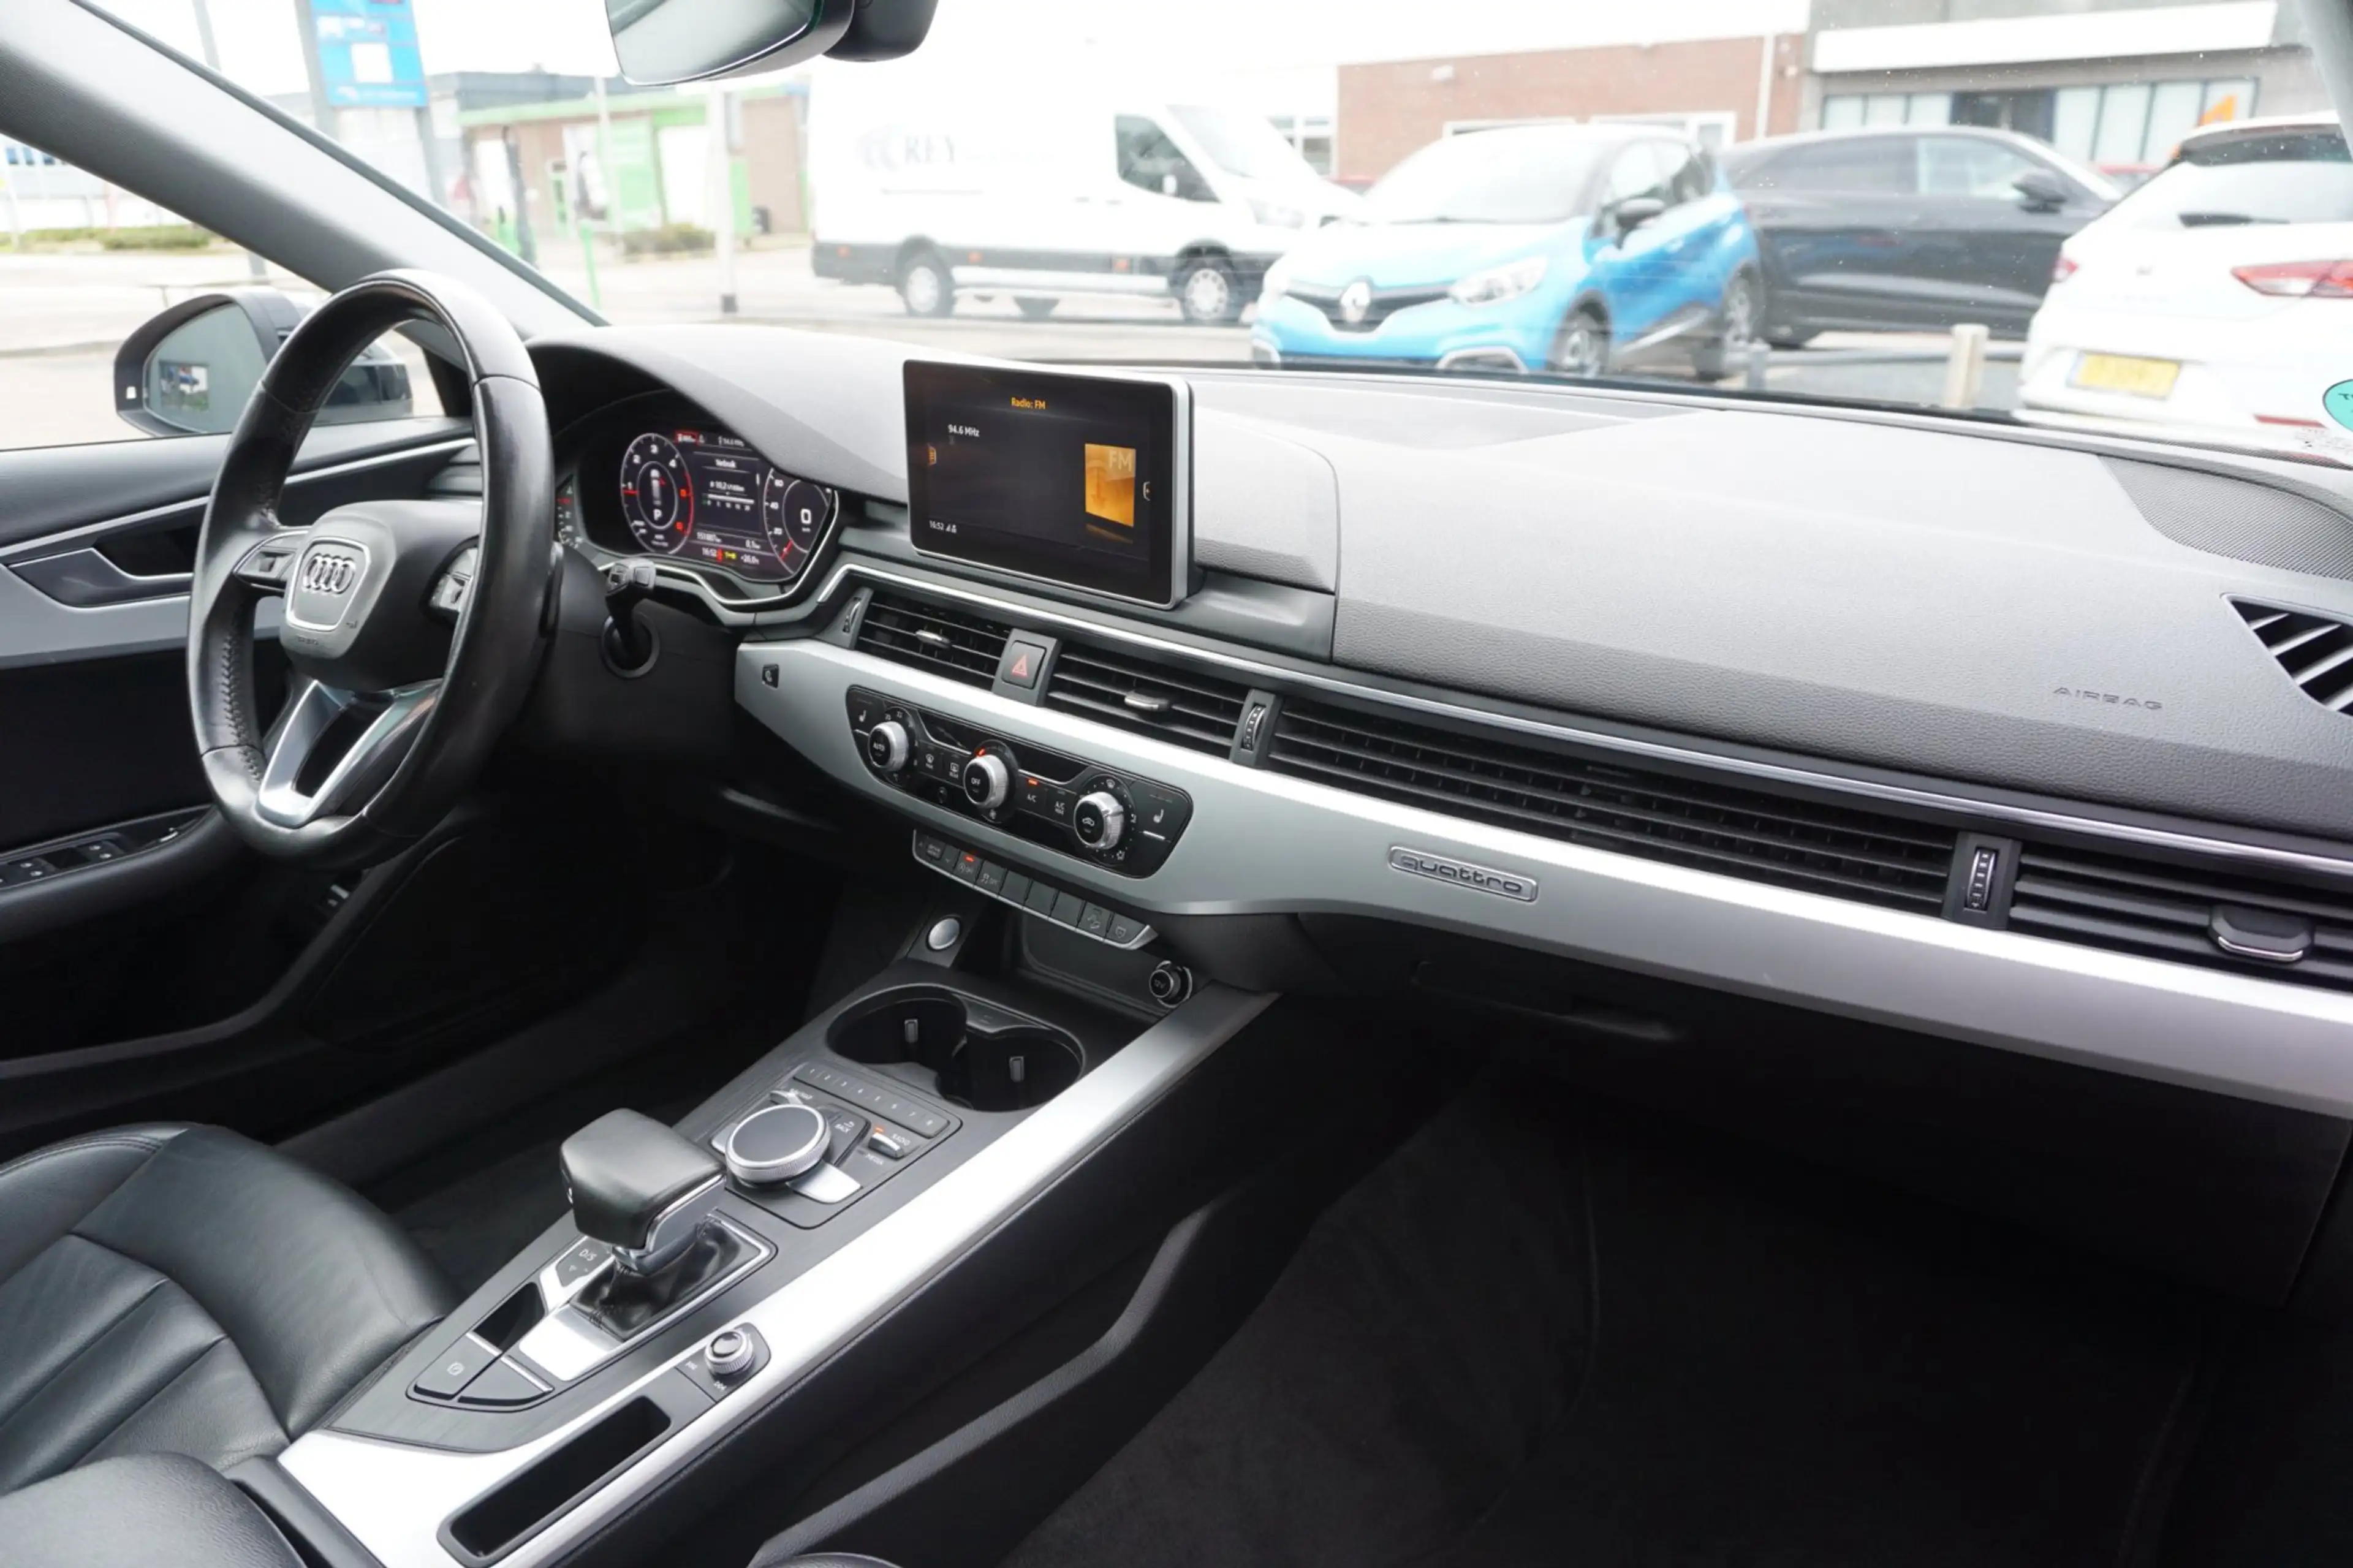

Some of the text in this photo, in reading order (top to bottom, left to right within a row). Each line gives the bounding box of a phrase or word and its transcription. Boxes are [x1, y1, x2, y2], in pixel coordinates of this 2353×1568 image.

[1011, 397, 1045, 409] Radio: FM
[948, 424, 980, 437] 94.6 MHz
[1109, 450, 1132, 472] FM
[800, 509, 811, 525] 0
[2053, 686, 2163, 710] AIRBAG
[873, 742, 885, 752] AUTO
[971, 776, 981, 786] OFF
[1401, 855, 1523, 893] quattro
